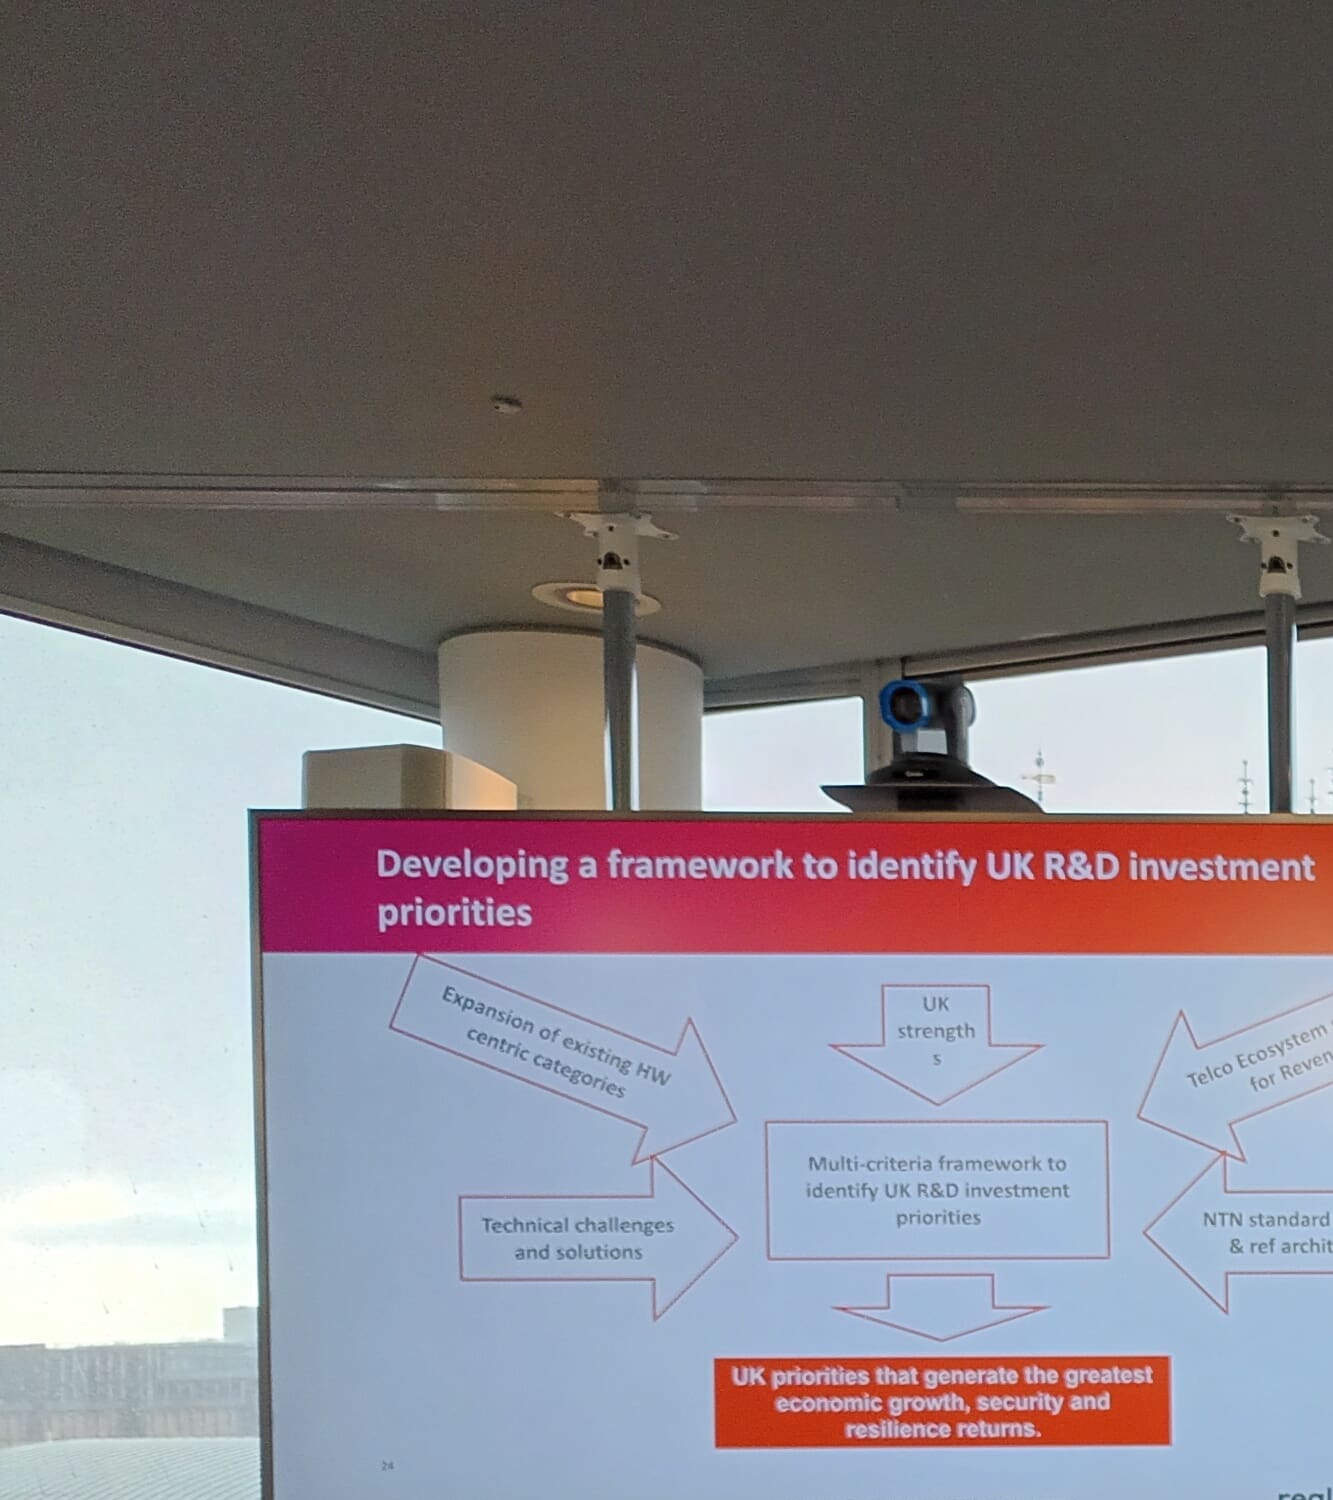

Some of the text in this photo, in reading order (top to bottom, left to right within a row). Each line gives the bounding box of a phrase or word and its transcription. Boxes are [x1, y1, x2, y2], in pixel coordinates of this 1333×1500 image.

[376, 848, 1316, 887] Developing a framework to identify UK R&D investment
[377, 898, 533, 933] priorities
[922, 996, 950, 1013] UK
[440, 984, 673, 1088] Expansion of existing HW
[897, 1019, 976, 1043] strength
[465, 1024, 629, 1102] centric categories
[932, 1053, 942, 1066] s
[1186, 1058, 1236, 1090] Telco
[1235, 1019, 1328, 1069] Ecosystem
[1248, 1071, 1278, 1095] for
[808, 1153, 1068, 1173] Multi-criteria framework to
[806, 1179, 1070, 1202] identify UK R&D investment
[482, 1215, 675, 1239] Technical challenges
[897, 1208, 982, 1229] priorities
[1204, 1211, 1244, 1229] NTN
[1249, 1209, 1331, 1229] standard
[515, 1242, 643, 1262] and solutions
[1230, 1237, 1244, 1255] &
[1249, 1236, 1276, 1255] ref
[732, 1365, 1153, 1391] UK priorities that generate the greatest
[775, 1391, 1111, 1417] economic growth, security and
[844, 1419, 1042, 1439] resilience returns.
